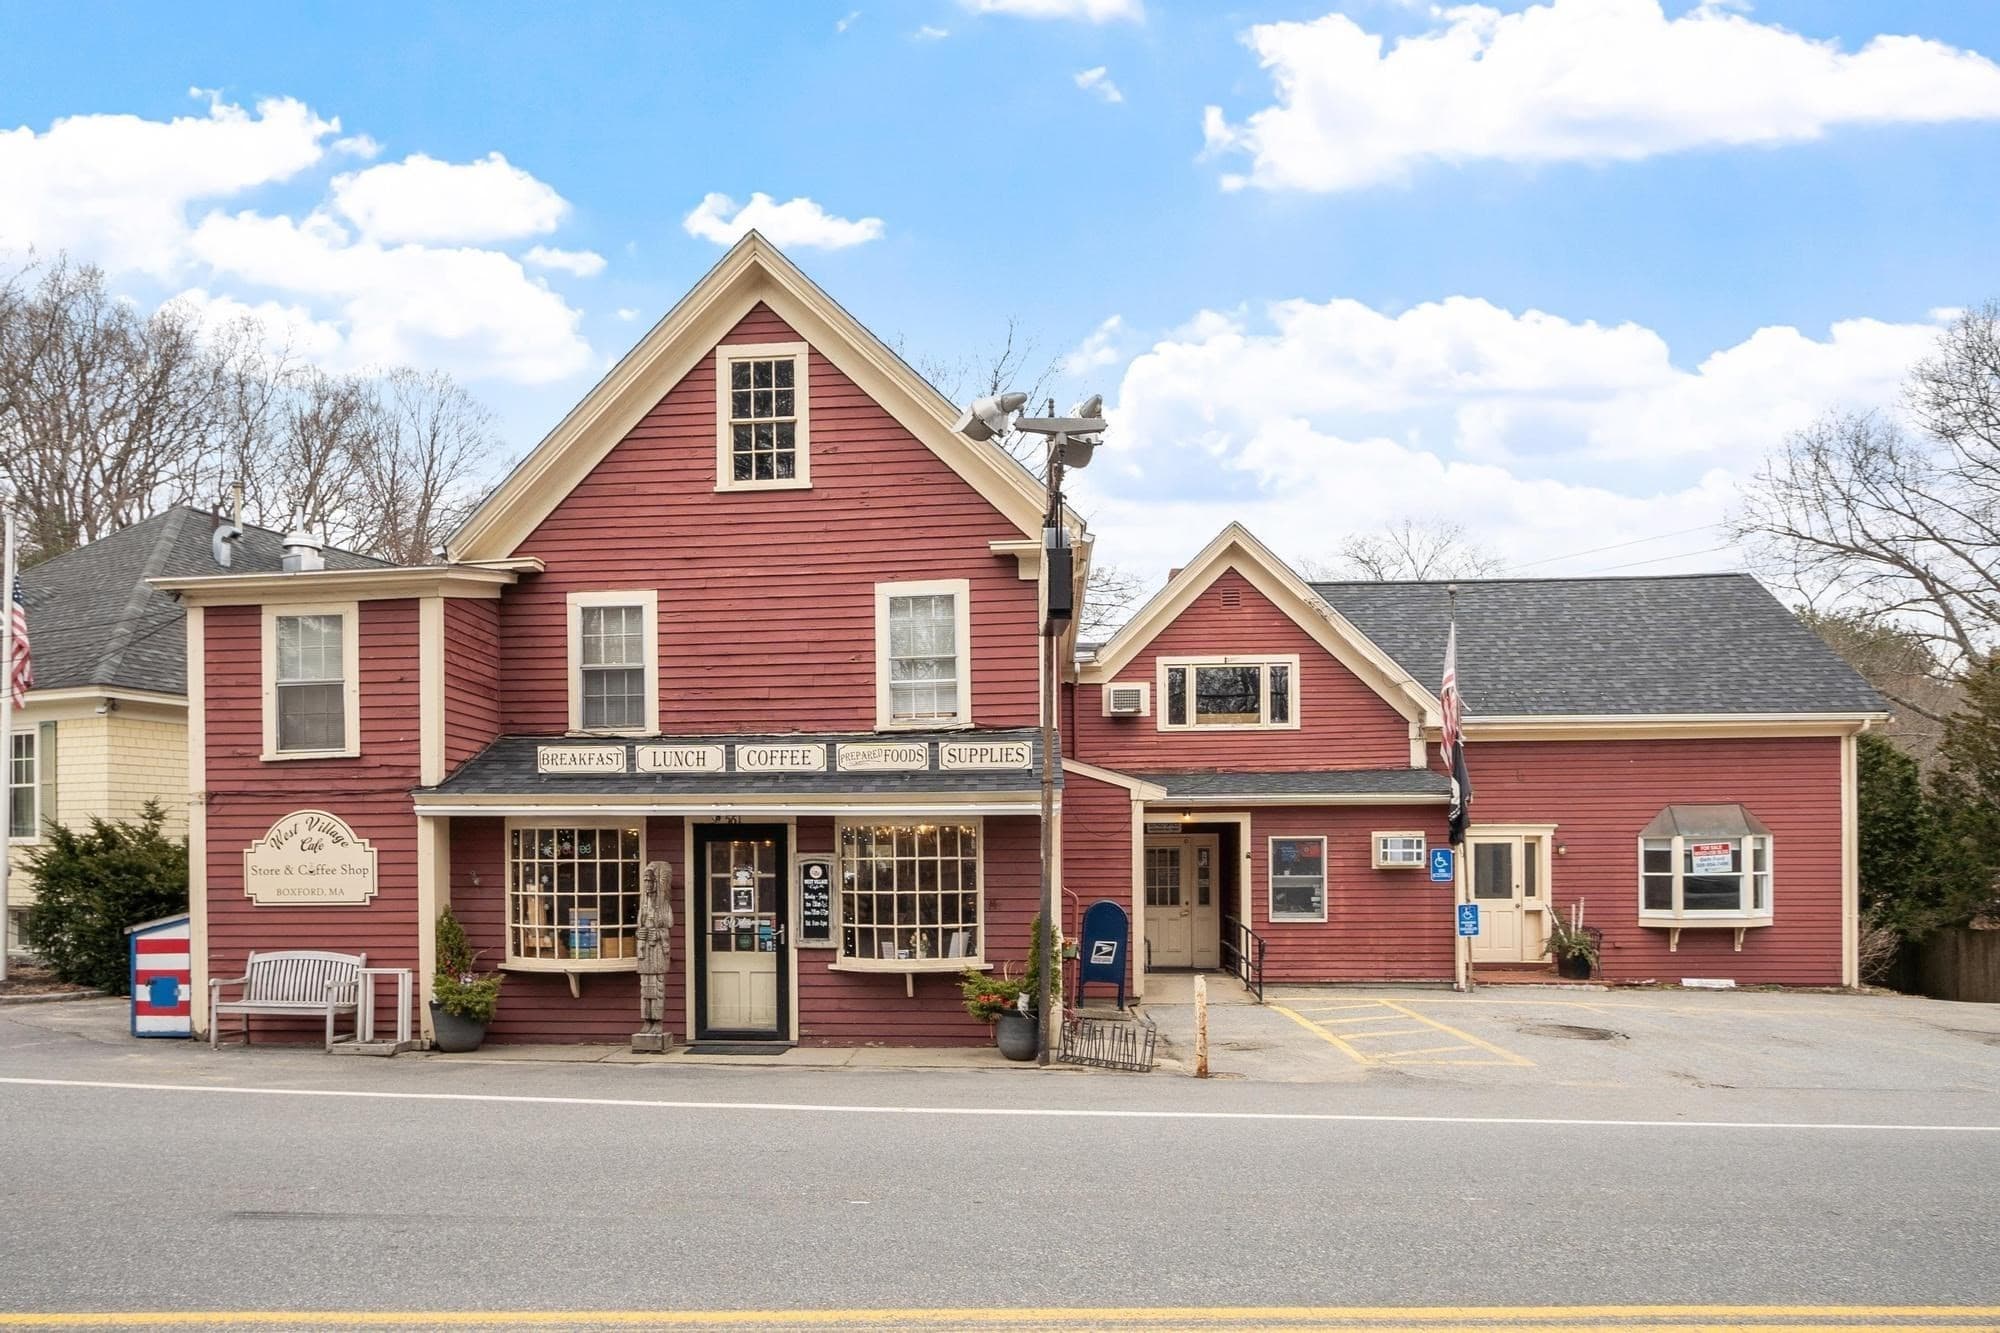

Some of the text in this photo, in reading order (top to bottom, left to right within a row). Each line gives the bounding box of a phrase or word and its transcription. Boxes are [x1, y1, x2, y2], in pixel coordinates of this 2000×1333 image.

[542, 752, 621, 766] BREAKFAST
[653, 750, 706, 767] LUNCH
[746, 749, 811, 766] COFFEE
[840, 748, 924, 763] PREPARED FOODS
[947, 747, 1025, 763] SUPPLIES
[270, 816, 349, 850] West Village
[251, 864, 281, 876] Store
[283, 865, 294, 876] &
[341, 864, 369, 878] Shop
[276, 888, 345, 897] BOXFORD, MA
